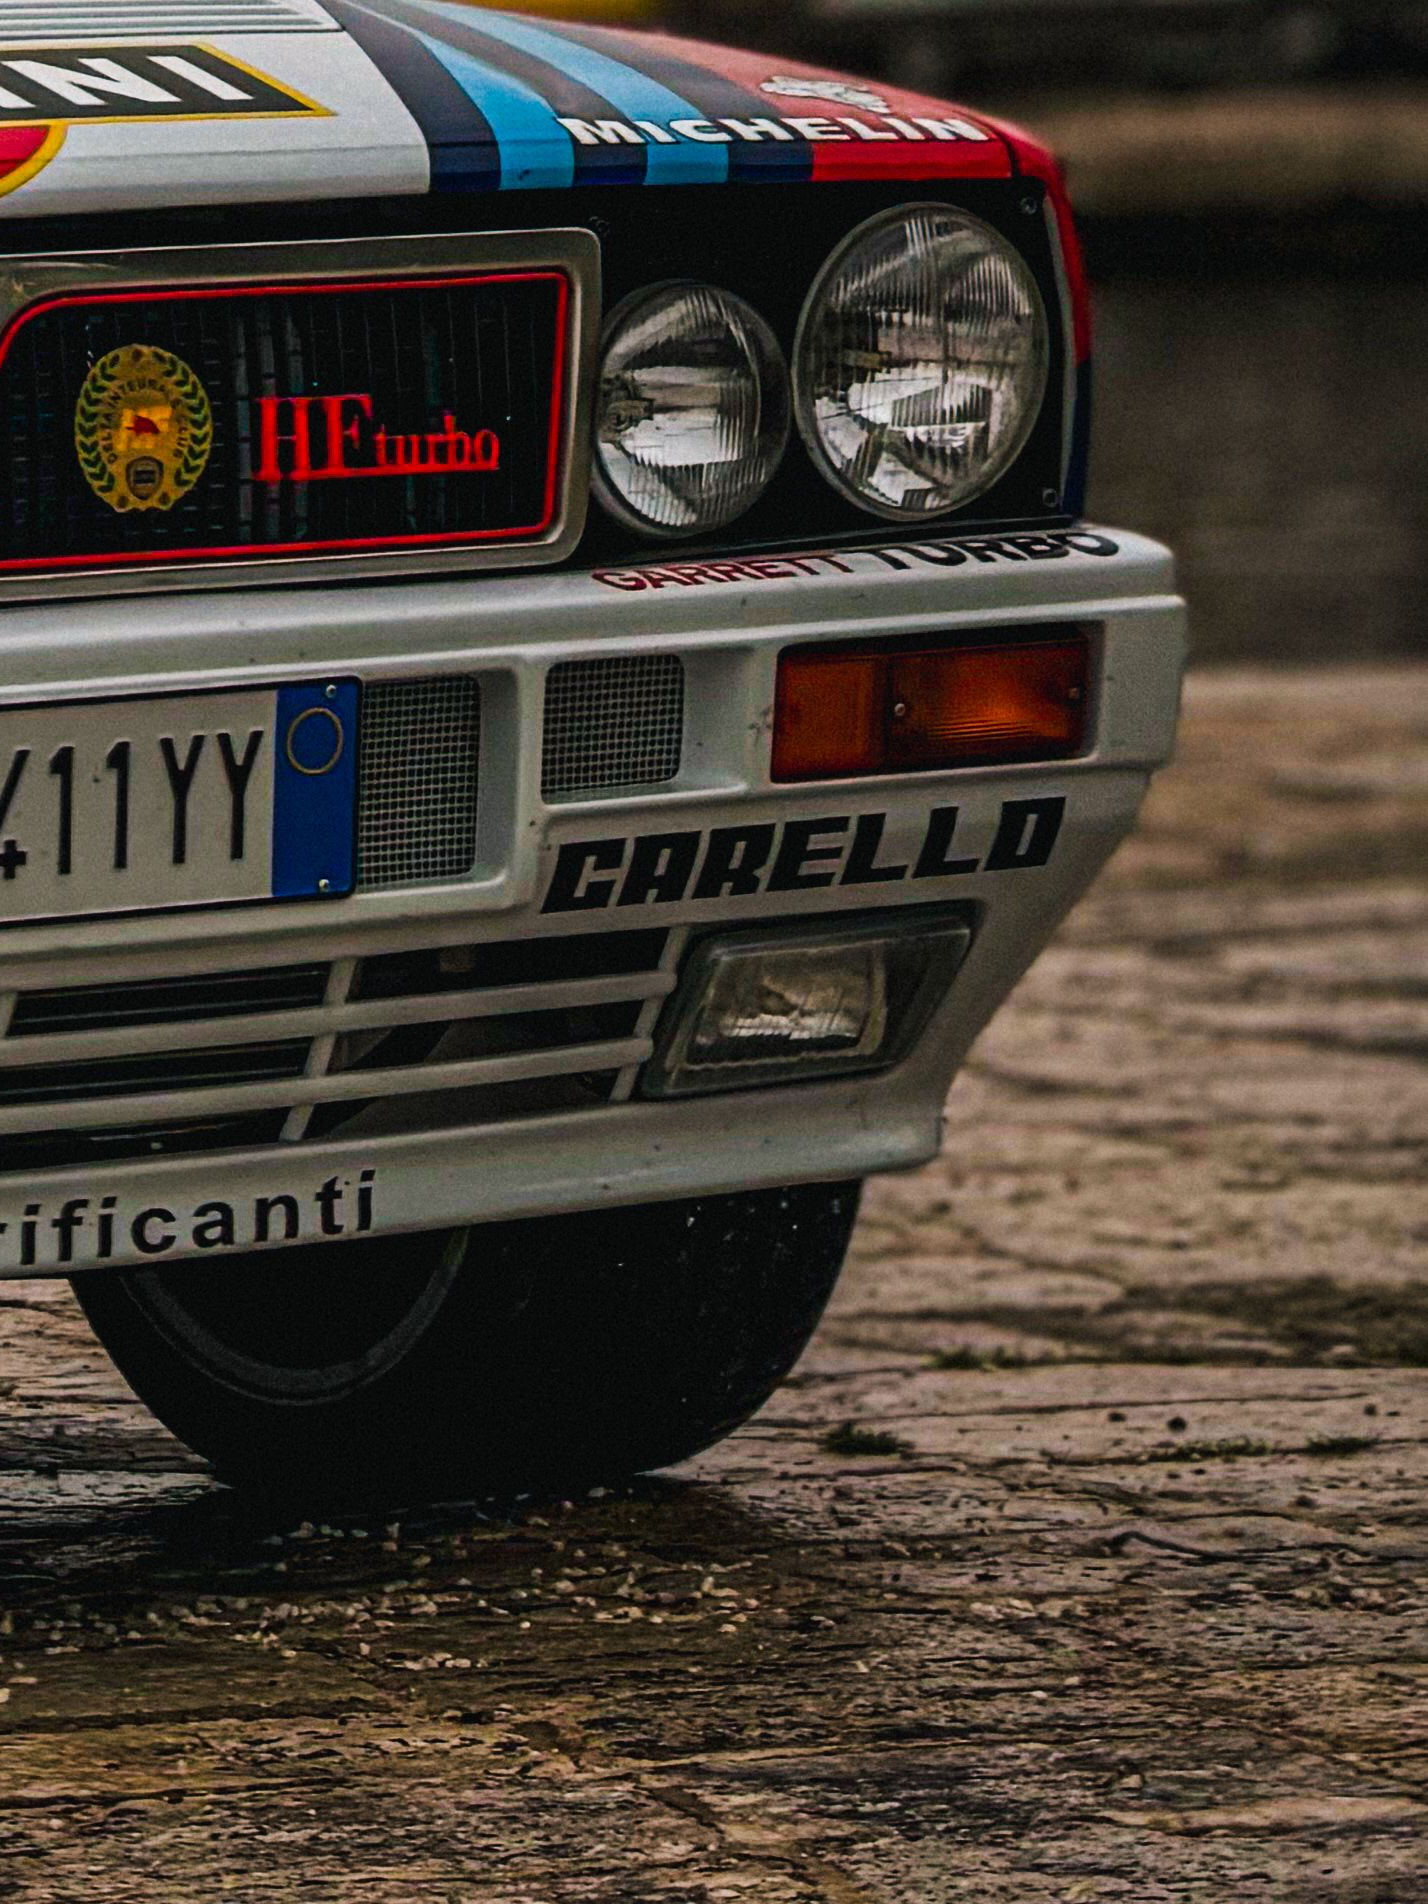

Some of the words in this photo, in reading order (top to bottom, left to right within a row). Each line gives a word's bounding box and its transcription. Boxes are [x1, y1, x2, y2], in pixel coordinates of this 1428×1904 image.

[556, 116, 995, 145] MICHELIN
[252, 393, 373, 482] HF
[373, 410, 501, 472] turbo
[592, 553, 855, 591] GARRETT
[845, 526, 1120, 571] TURBO
[540, 797, 1066, 914] CARELLO
